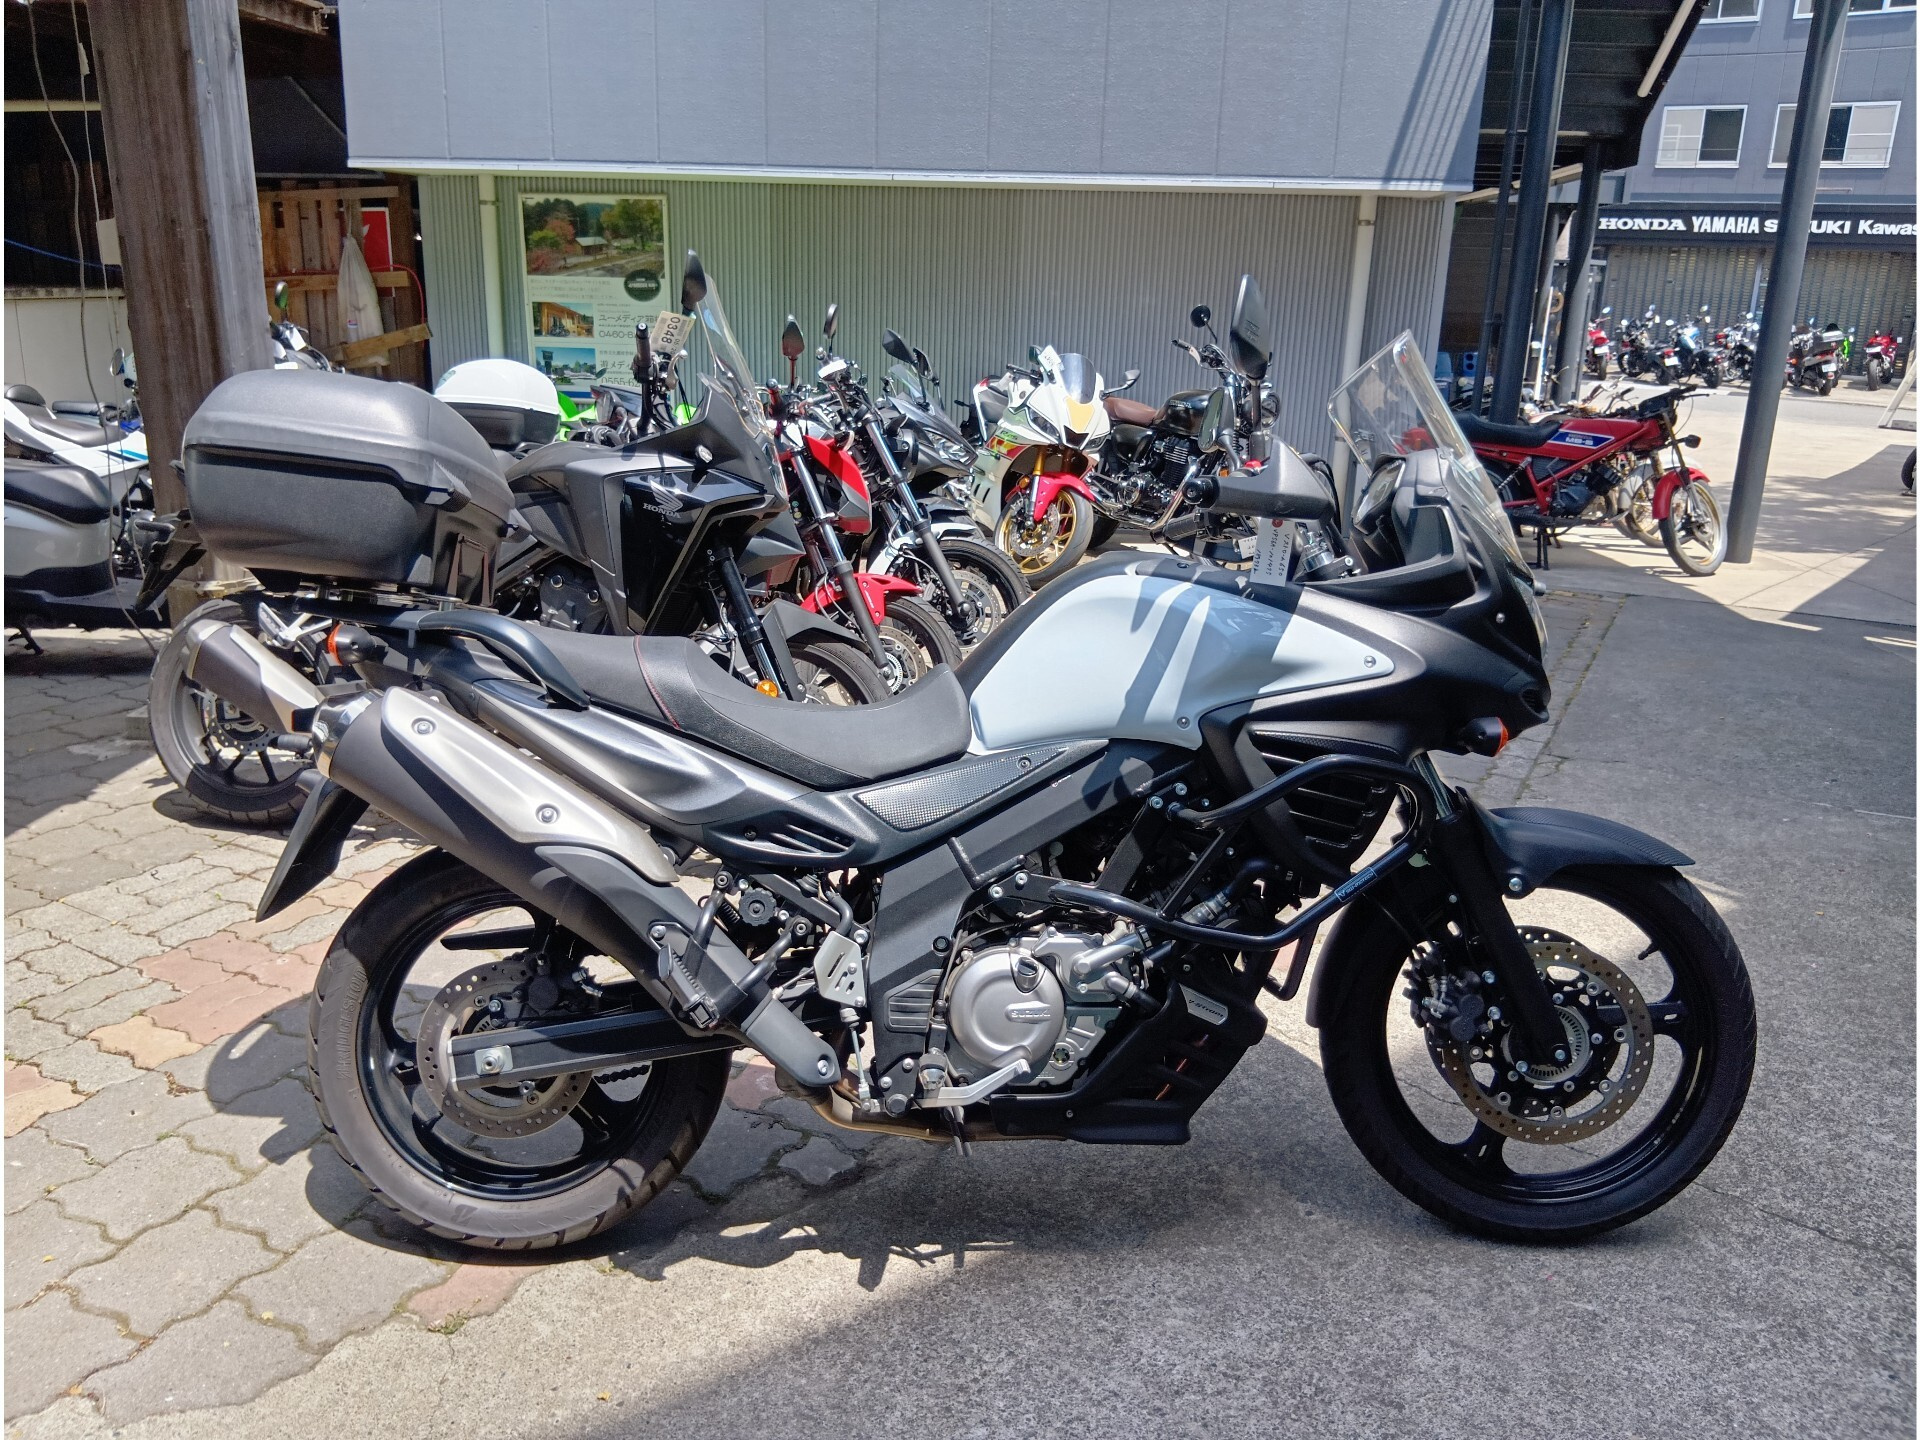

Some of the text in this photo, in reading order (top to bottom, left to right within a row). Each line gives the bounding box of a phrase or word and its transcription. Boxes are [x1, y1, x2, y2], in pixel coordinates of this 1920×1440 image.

[1598, 217, 1687, 231] HONDA
[1691, 215, 1760, 234] YAMAHA
[1763, 219, 1851, 234] SUKI
[598, 330, 637, 339] 0460-8
[661, 316, 681, 344] 0348
[642, 502, 681, 519] HONDA
[337, 965, 368, 1080] BRIDGESTON
[1011, 1009, 1051, 1018] SUZUKI
